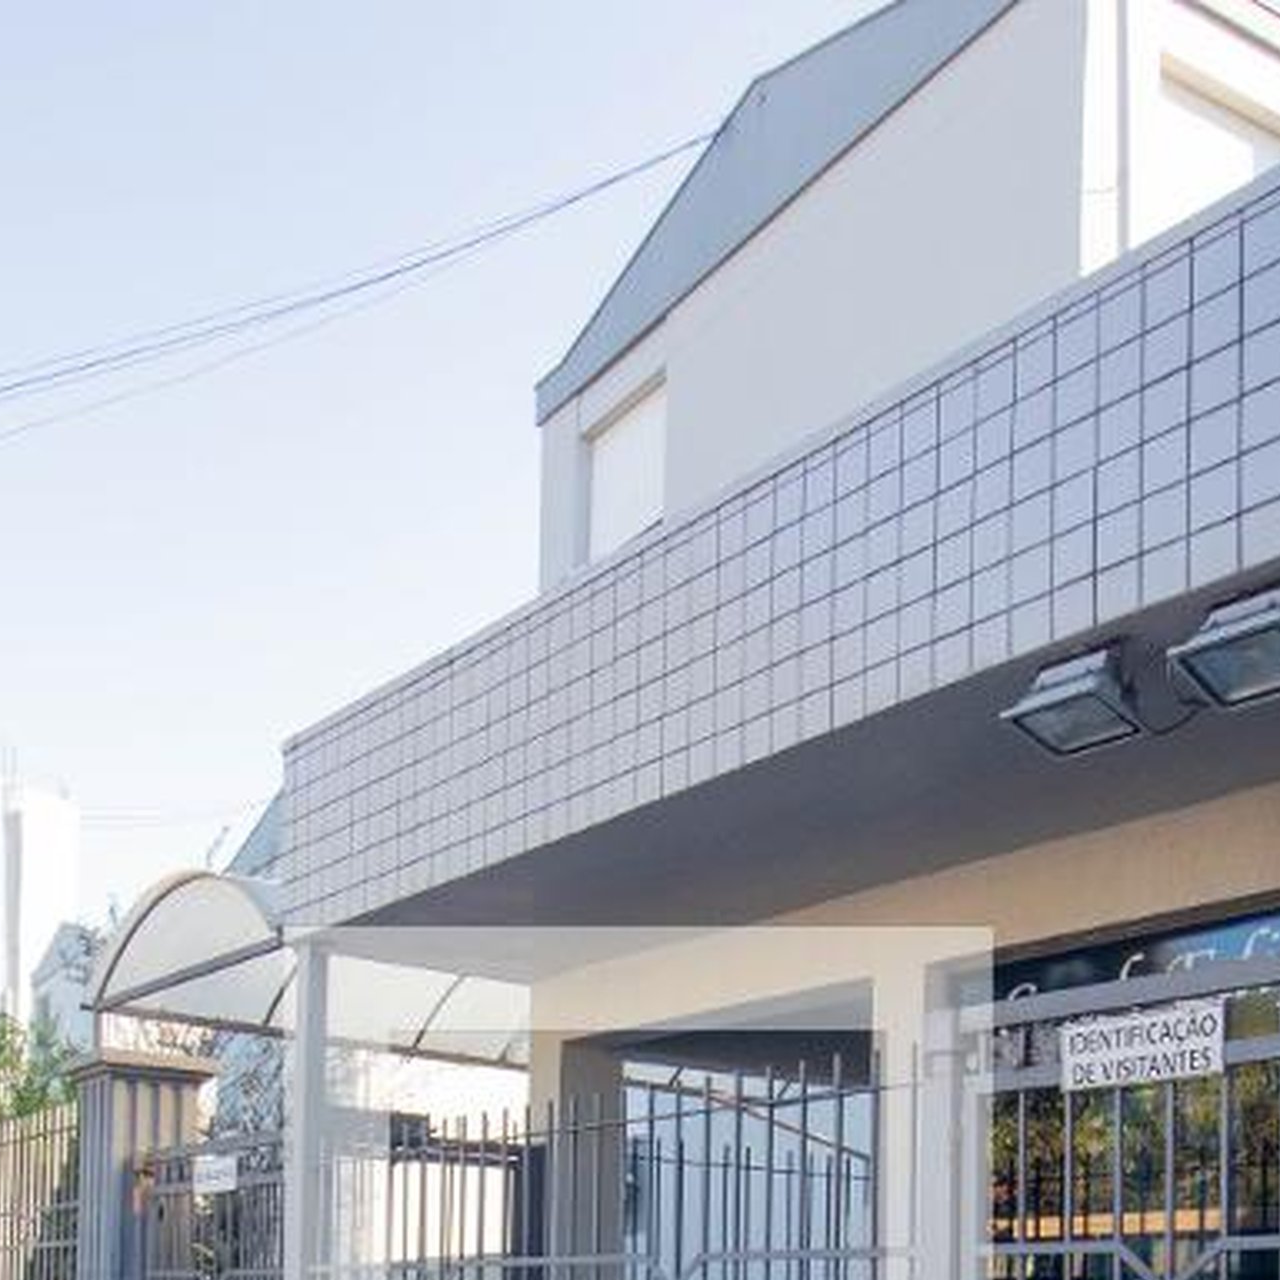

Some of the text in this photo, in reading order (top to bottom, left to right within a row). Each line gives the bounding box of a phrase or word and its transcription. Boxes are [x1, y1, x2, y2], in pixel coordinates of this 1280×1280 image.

[1070, 1010, 1218, 1055] IDENTIFICAÇÃO
[1072, 1046, 1212, 1086] DE VISITANTES
